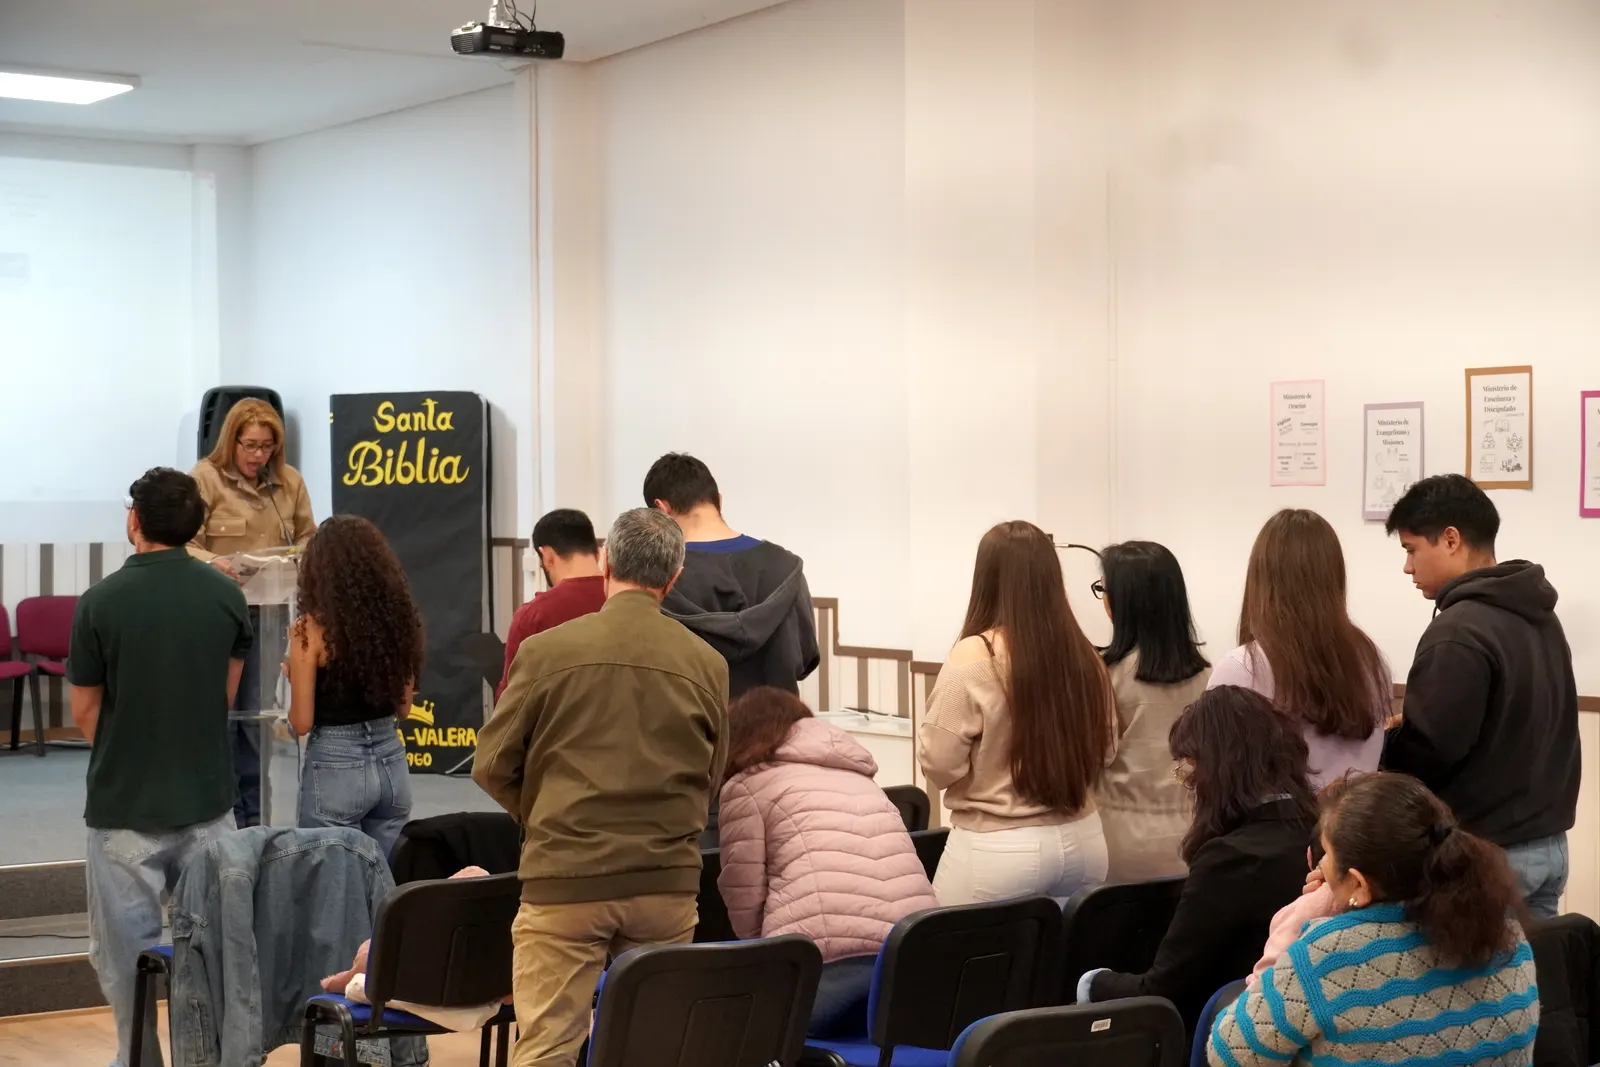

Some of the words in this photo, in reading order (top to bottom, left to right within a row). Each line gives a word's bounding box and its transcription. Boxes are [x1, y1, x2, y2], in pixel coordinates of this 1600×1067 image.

[373, 398, 455, 433] Santa
[343, 437, 470, 486] Biblia
[406, 752, 432, 767] 960
